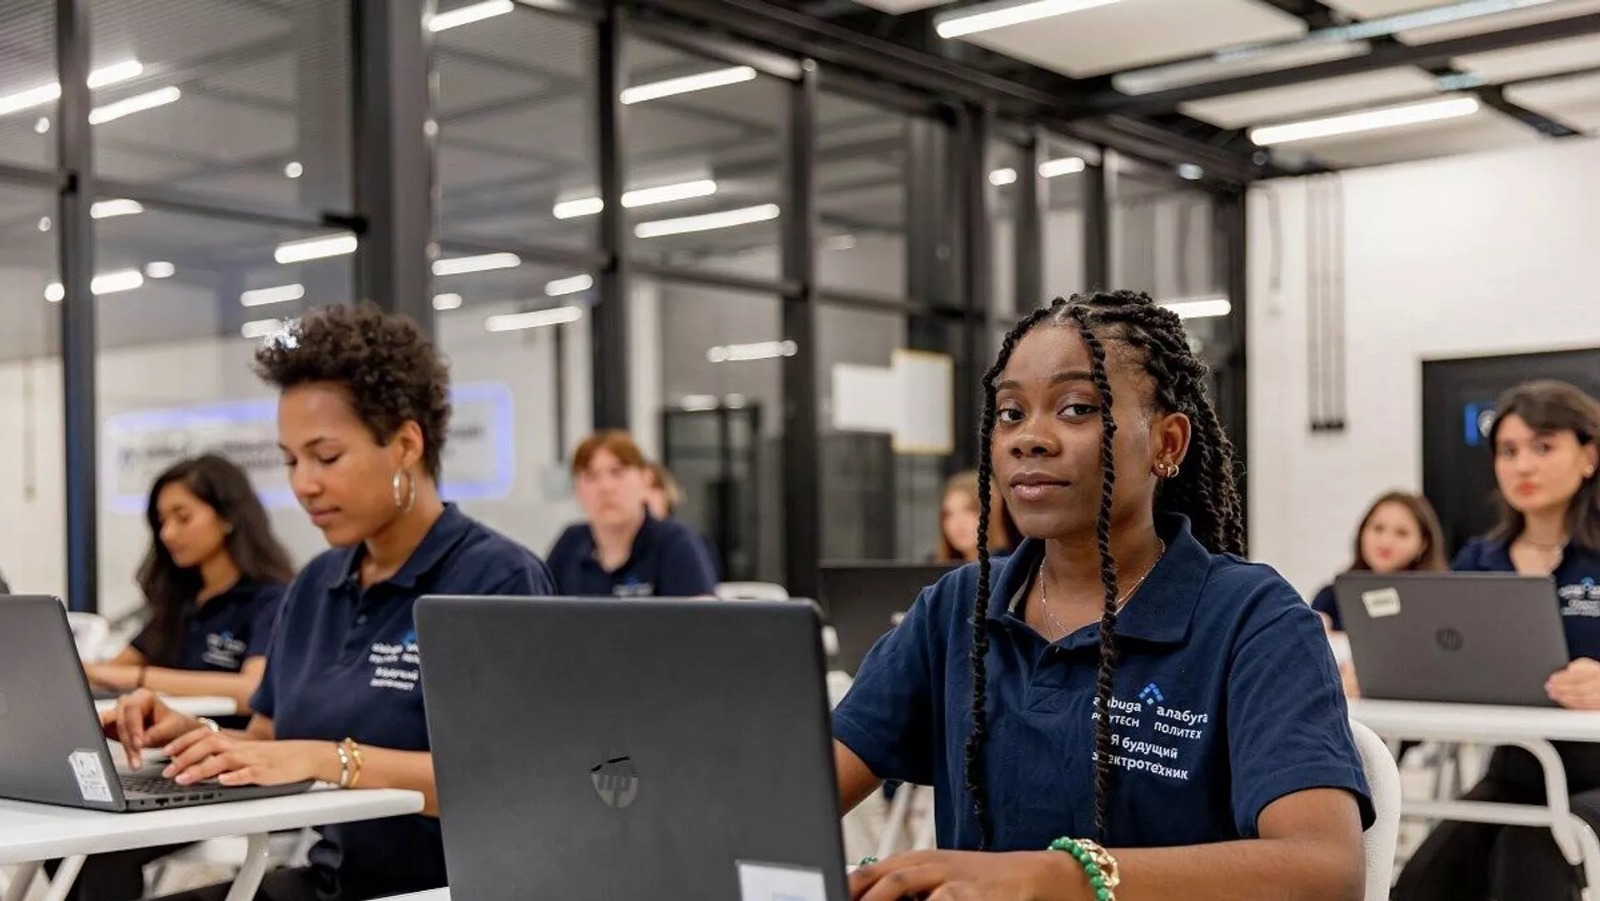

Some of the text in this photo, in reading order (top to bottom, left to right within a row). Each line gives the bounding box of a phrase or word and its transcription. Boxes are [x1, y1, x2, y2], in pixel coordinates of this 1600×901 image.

[1092, 696, 1142, 713] abuga
[1091, 712, 1140, 728] PYTECH
[1156, 706, 1209, 726] алабуга
[1154, 721, 1203, 740] ПОЛИТЕХ
[1110, 734, 1178, 760] Я будущий
[1091, 751, 1189, 781] эектротехник
